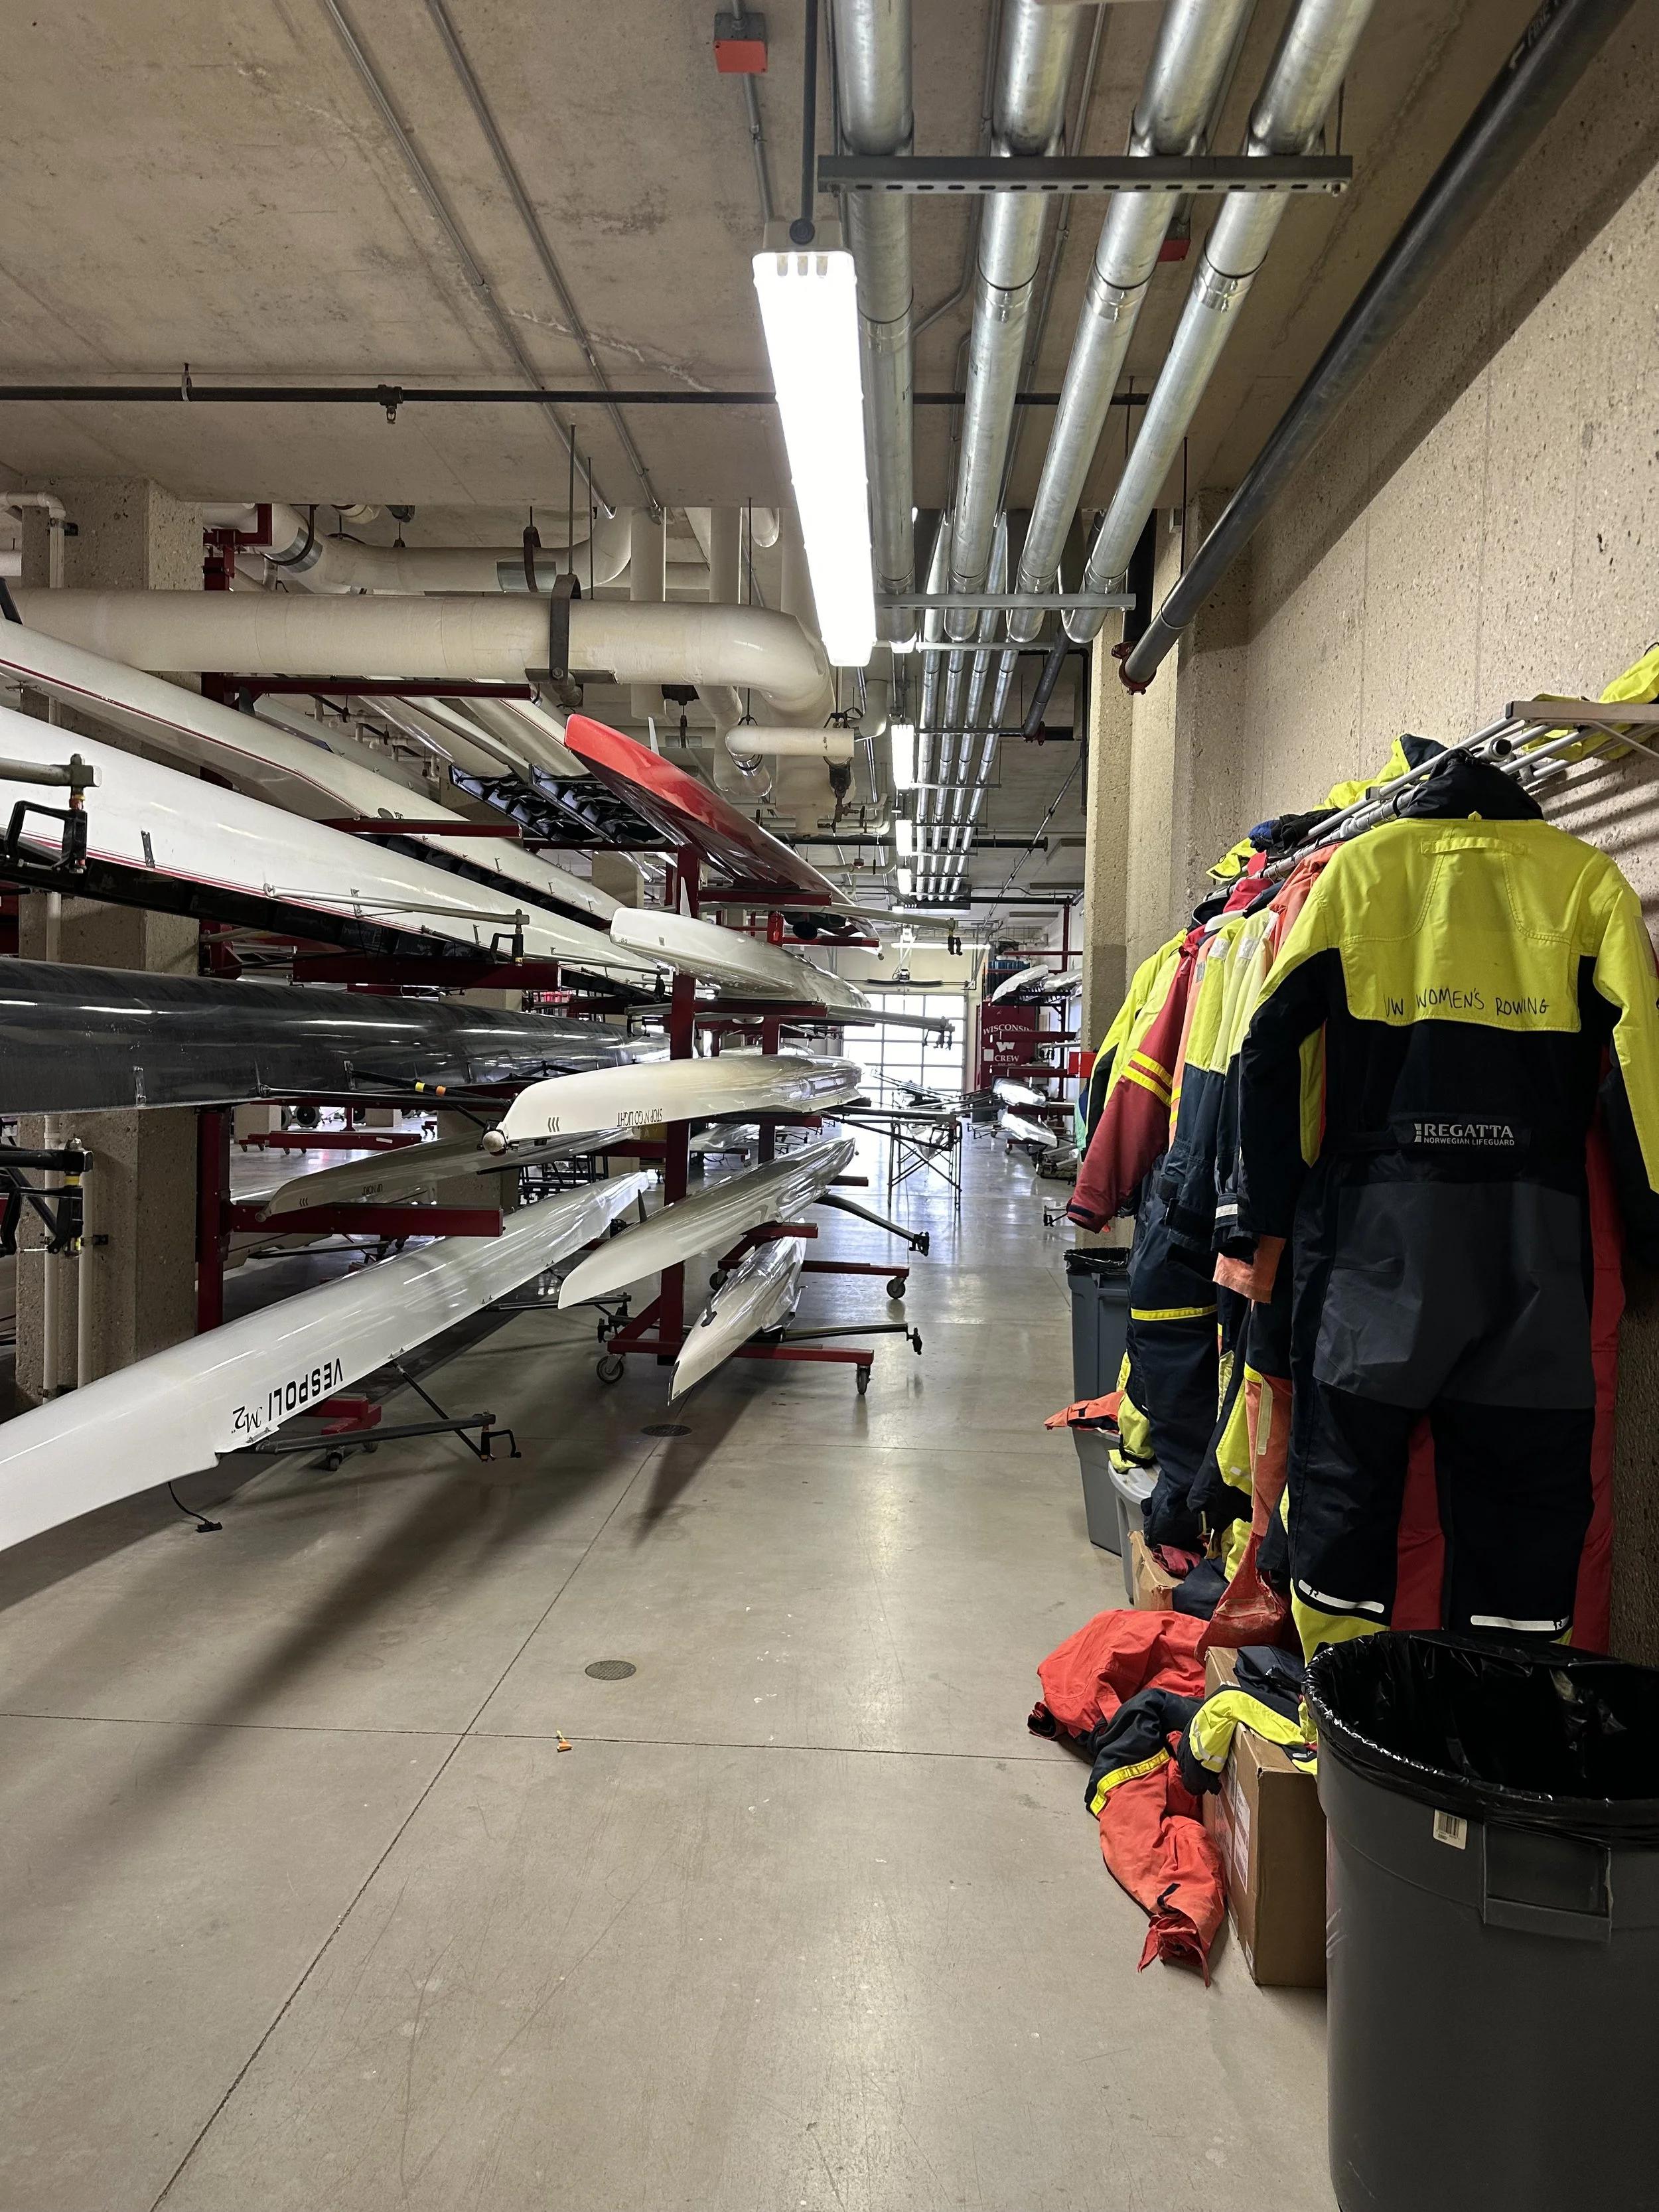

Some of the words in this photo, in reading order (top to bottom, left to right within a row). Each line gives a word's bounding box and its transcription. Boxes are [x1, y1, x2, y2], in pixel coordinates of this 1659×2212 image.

[1383, 994, 1404, 1017] UW
[1416, 988, 1485, 1010] WOMEN'S
[1495, 997, 1550, 1016] ROWING
[616, 1112, 634, 1127] LIGHT
[634, 1110, 644, 1125] GO
[650, 1108, 662, 1122] STOP
[1423, 1123, 1514, 1138] REGATTA
[268, 1358, 344, 1422] VESPOLI
